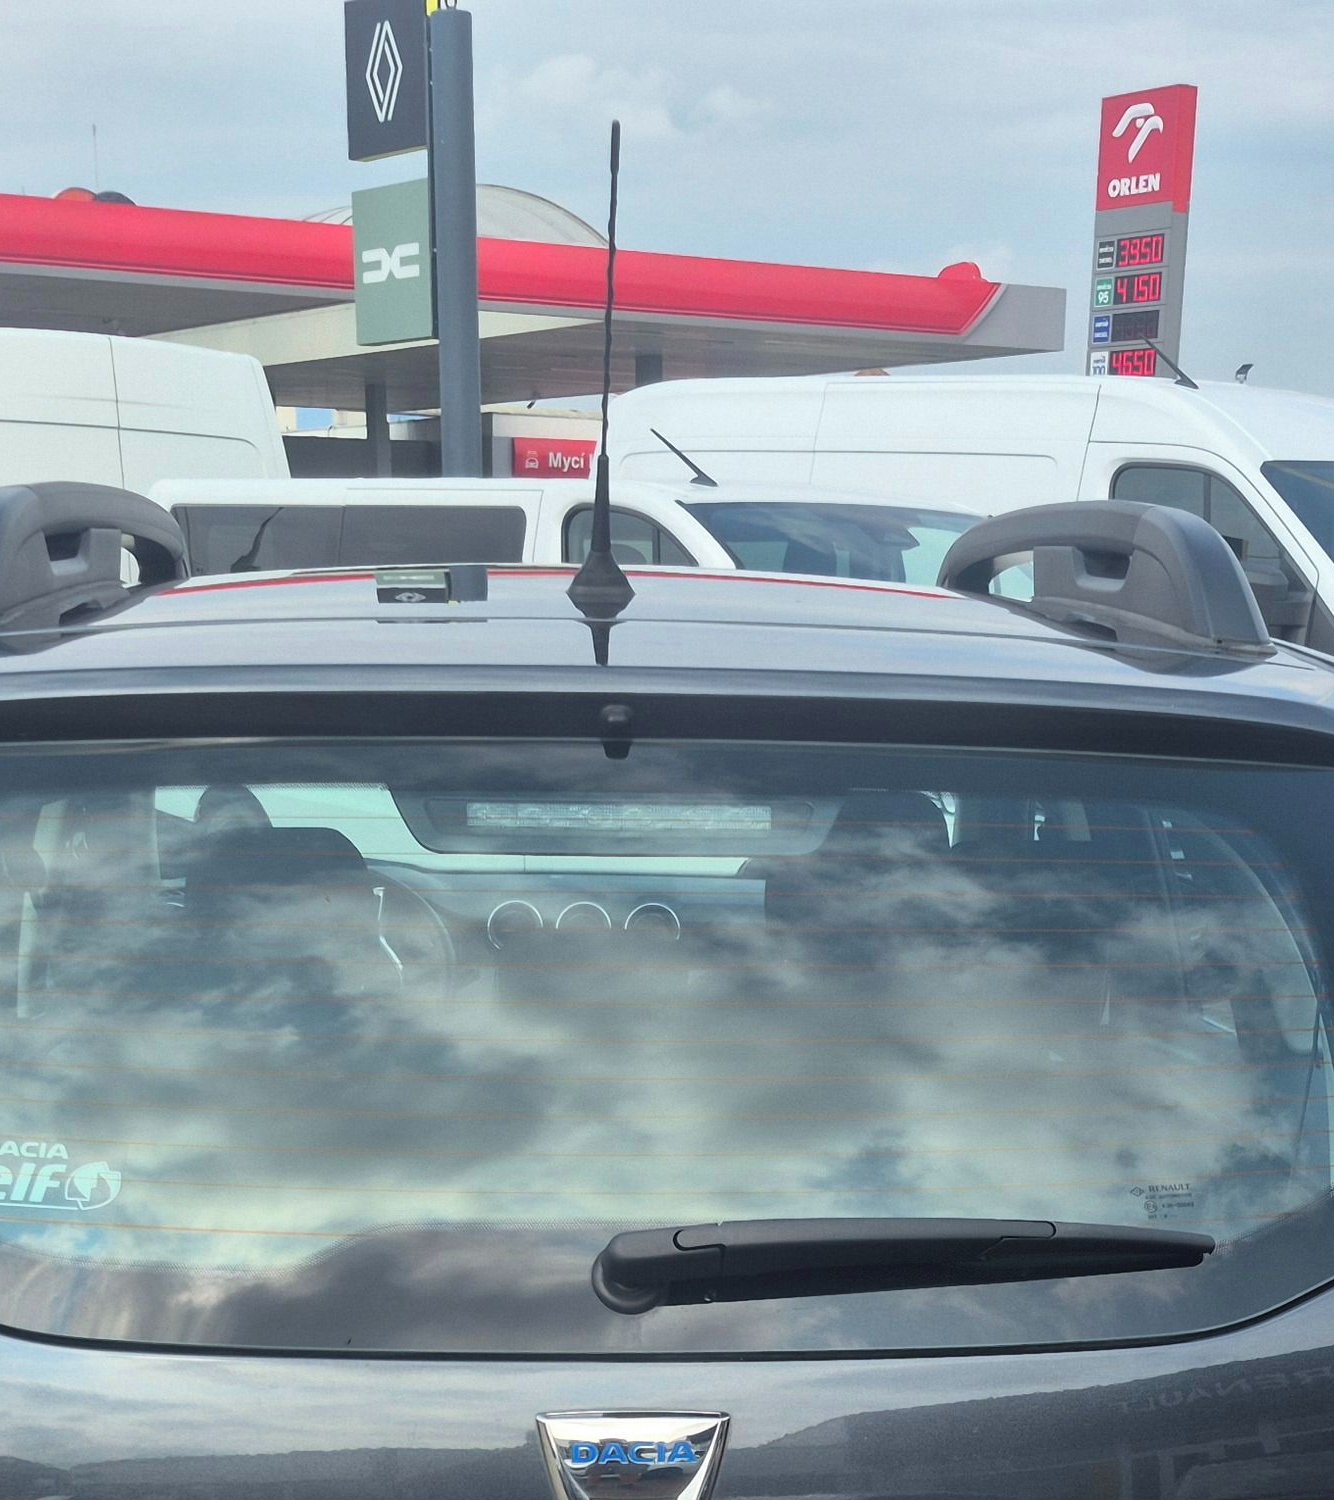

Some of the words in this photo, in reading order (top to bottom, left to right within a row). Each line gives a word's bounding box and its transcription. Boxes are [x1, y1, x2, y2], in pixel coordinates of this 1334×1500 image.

[1108, 173, 1161, 198] ORLEN
[1098, 291, 1109, 304] 95
[549, 452, 585, 472] Mycí
[1148, 1184, 1190, 1193] RENAULT
[570, 1441, 698, 1465] DACIA
